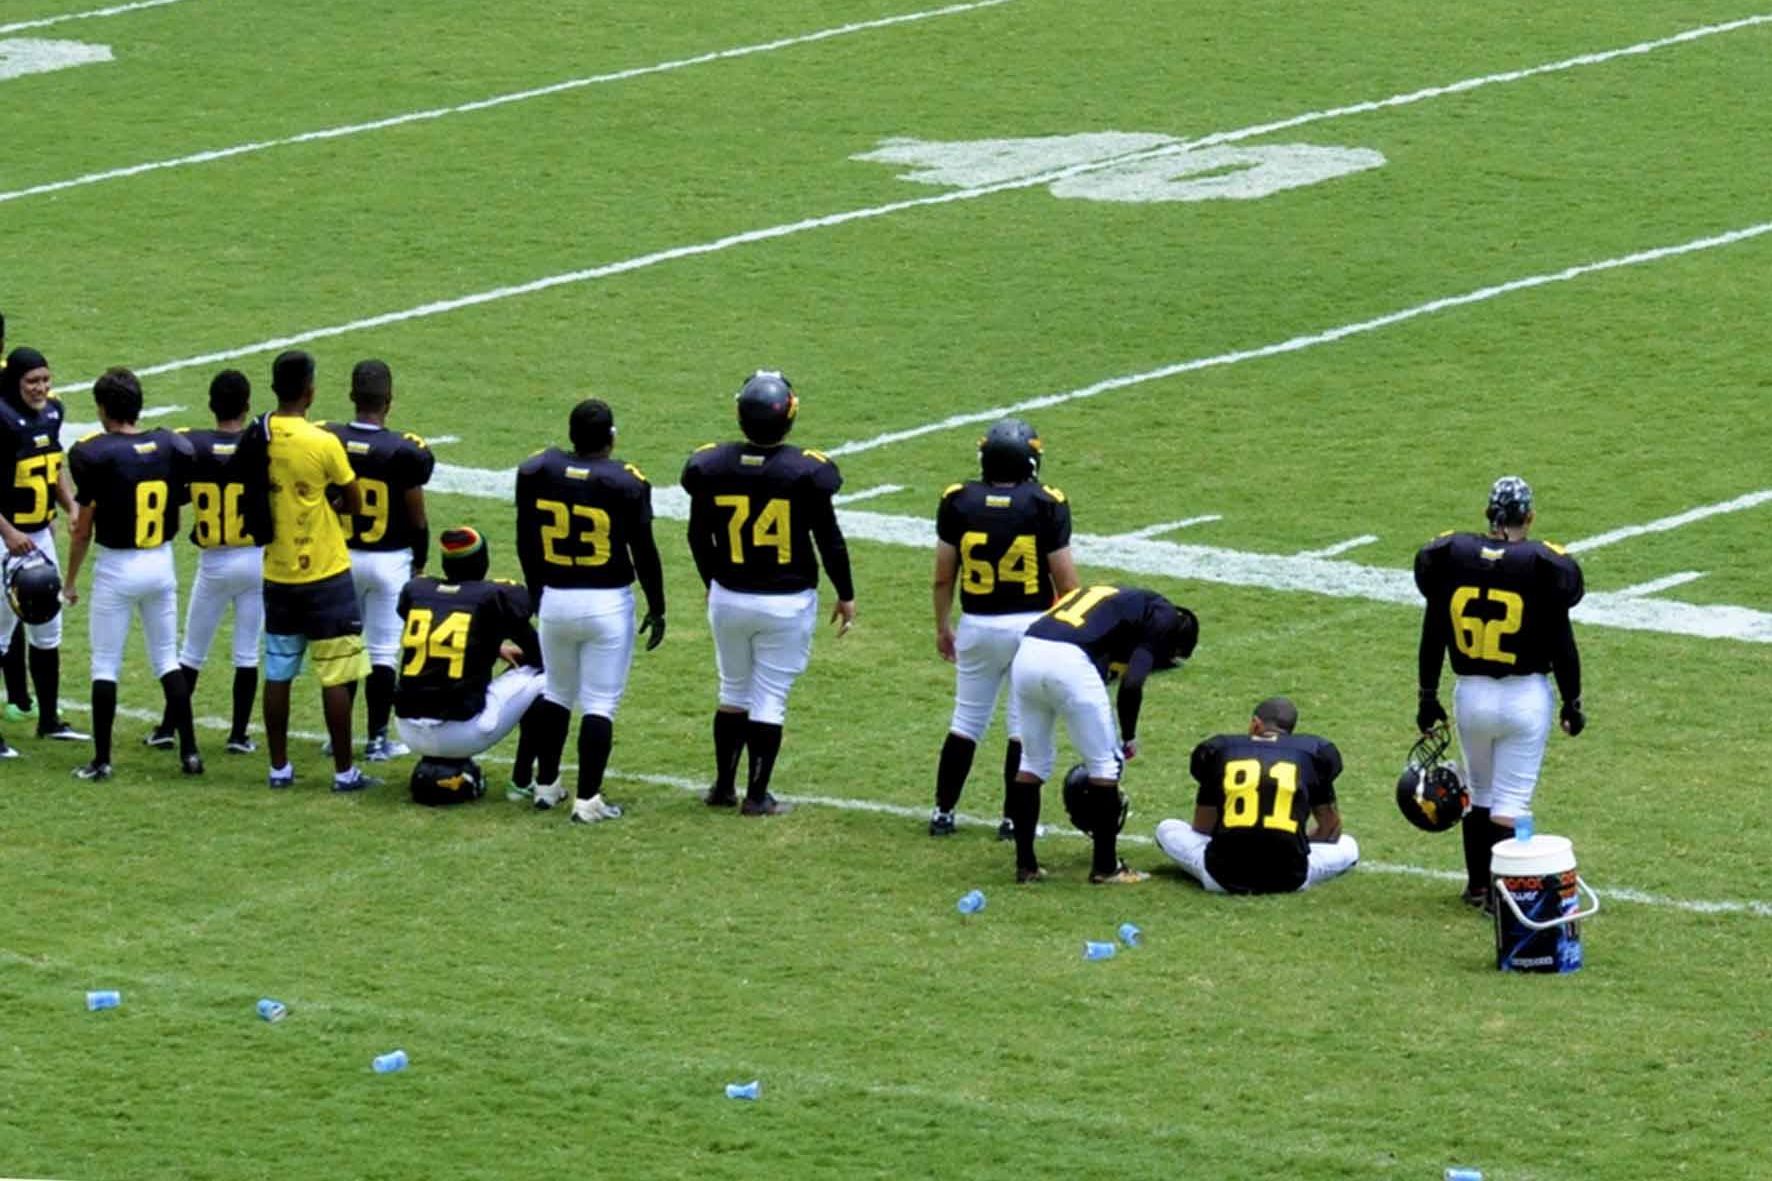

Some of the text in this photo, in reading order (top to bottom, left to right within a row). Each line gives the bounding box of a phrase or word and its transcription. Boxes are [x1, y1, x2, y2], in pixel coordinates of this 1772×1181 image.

[134, 479, 168, 549] 8
[535, 498, 612, 567] 23
[713, 494, 793, 565] 74
[959, 531, 1040, 596] 64
[402, 608, 473, 679] 94
[1450, 585, 1525, 666] 62
[1222, 758, 1299, 834] 81
